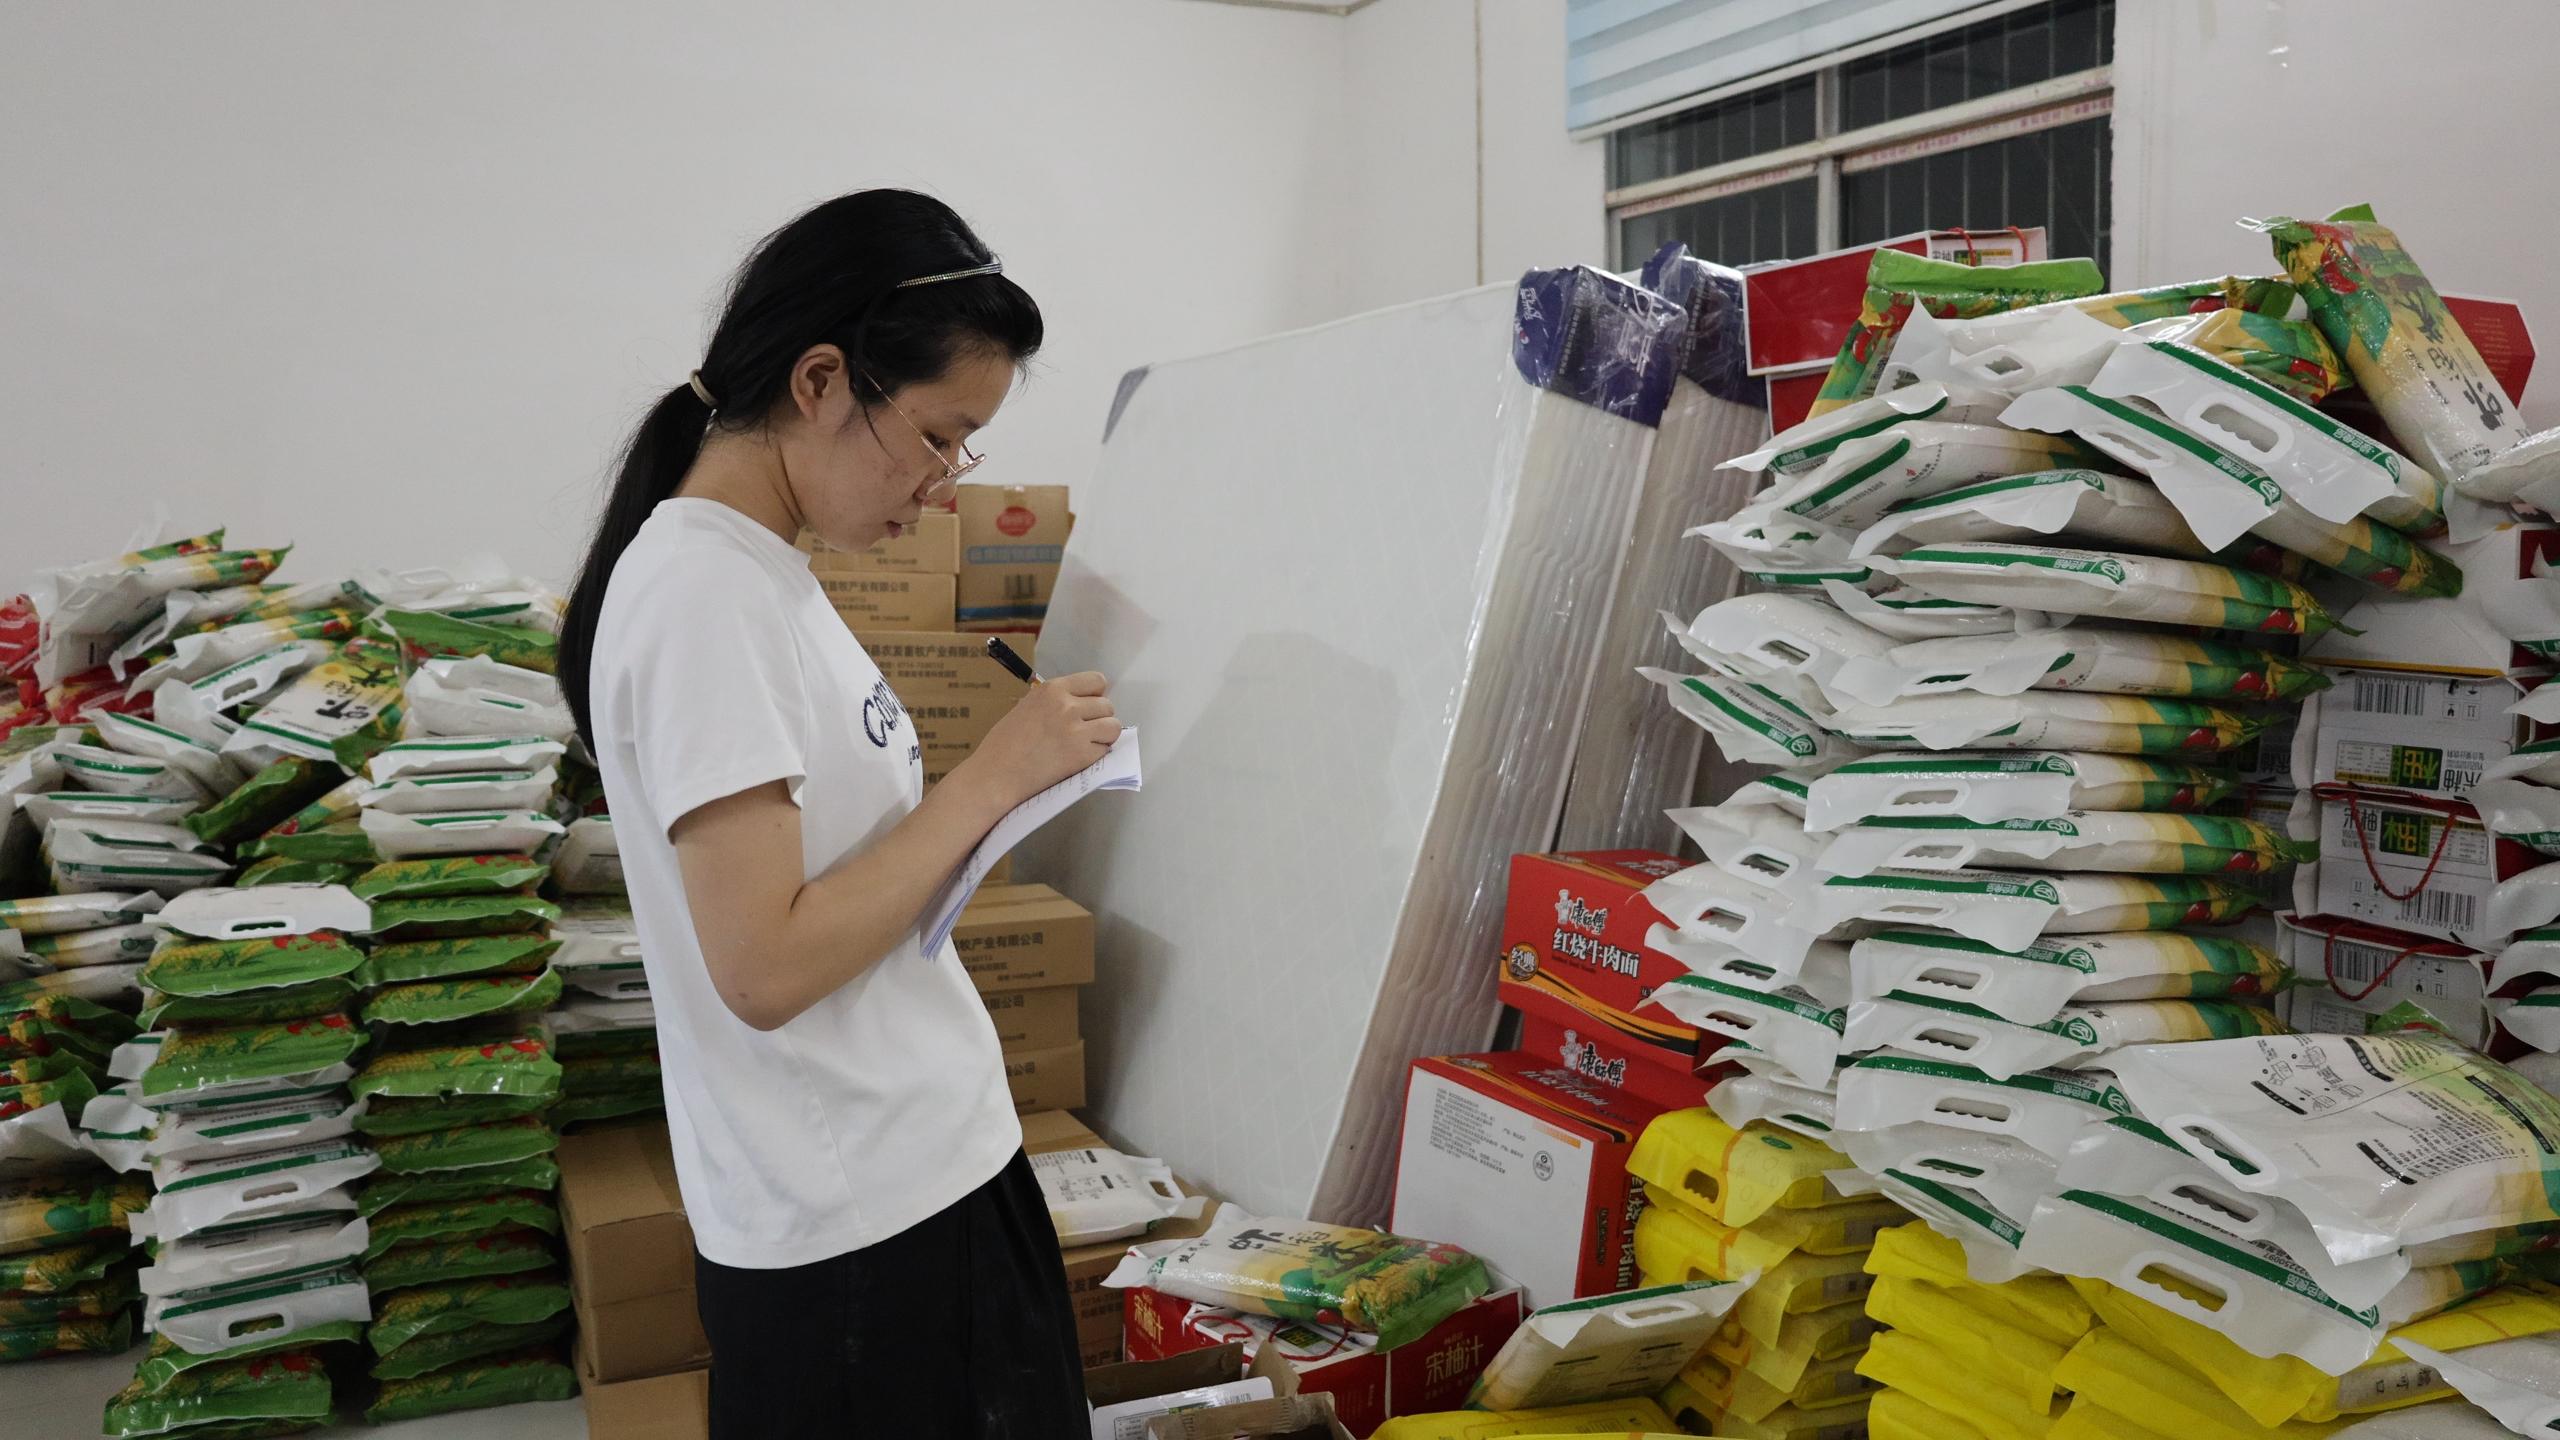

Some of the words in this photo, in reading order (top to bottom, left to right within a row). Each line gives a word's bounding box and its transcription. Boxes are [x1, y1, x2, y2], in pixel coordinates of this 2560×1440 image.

[1511, 947, 1537, 972] 经典
[1553, 928, 1640, 979] 红烧牛肉面
[1425, 1335, 1485, 1387] 宋柚汁
